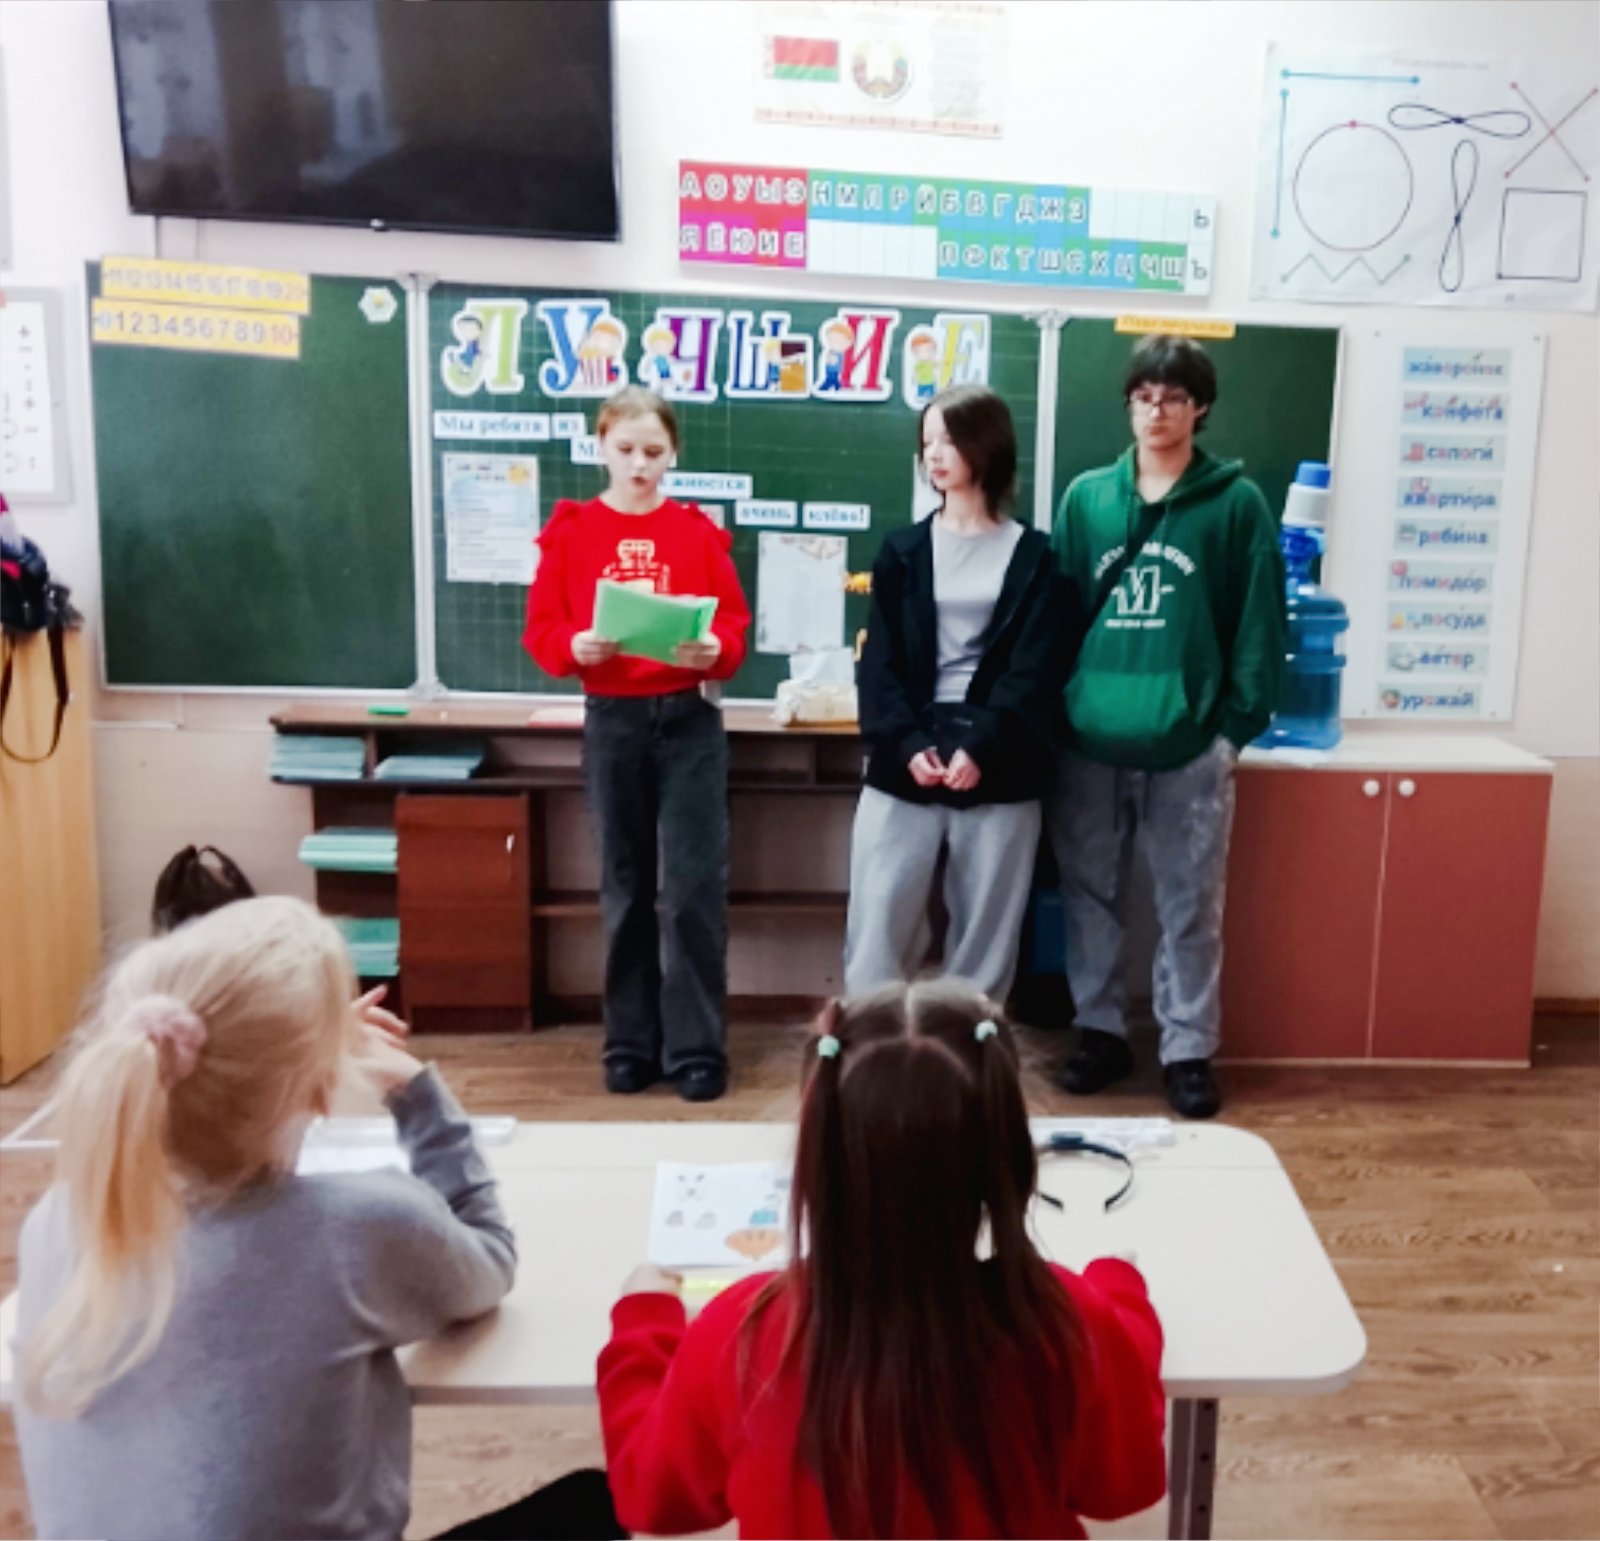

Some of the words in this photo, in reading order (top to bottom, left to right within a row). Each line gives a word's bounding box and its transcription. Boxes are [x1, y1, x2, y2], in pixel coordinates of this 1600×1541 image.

[1422, 400, 1503, 422] конфета
[1426, 446, 1493, 461] сапоги
[1404, 492, 1496, 511] квартира
[1400, 577, 1486, 594] помидор
[1421, 612, 1486, 630] посуда
[1402, 690, 1473, 711] урожай
